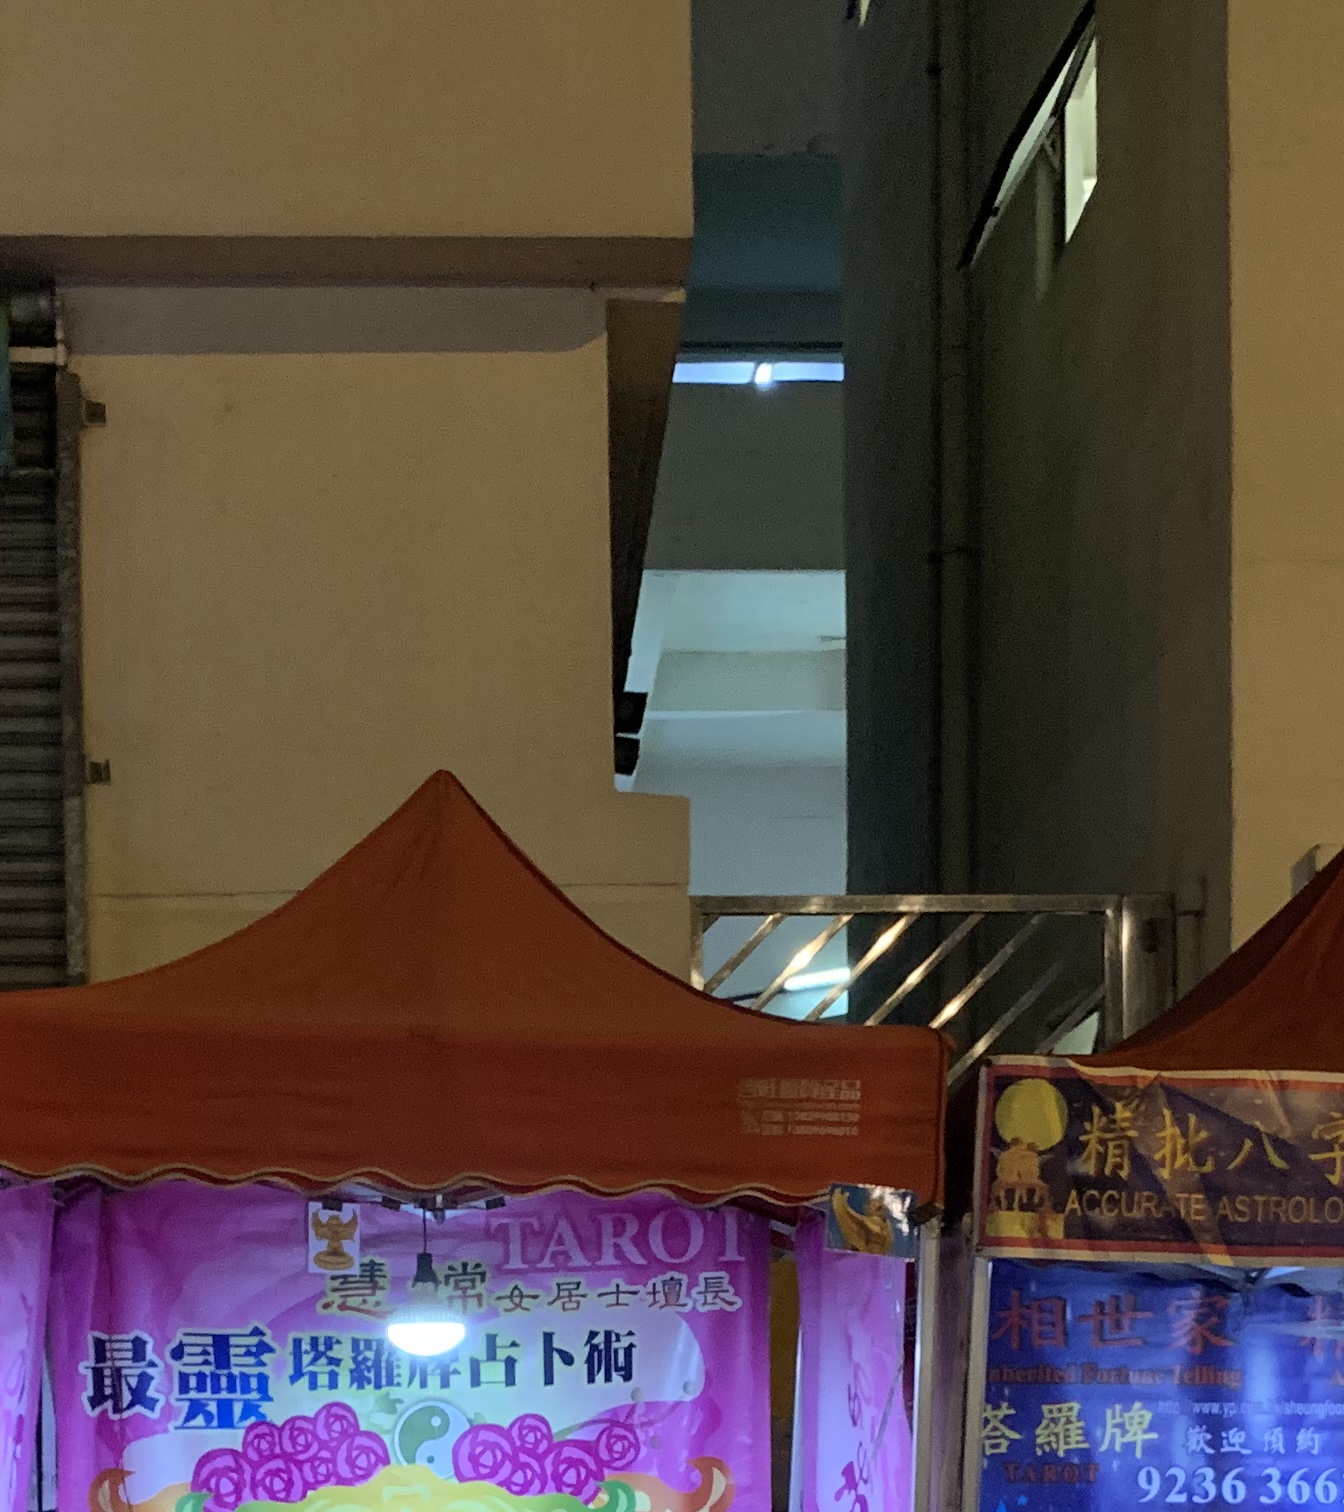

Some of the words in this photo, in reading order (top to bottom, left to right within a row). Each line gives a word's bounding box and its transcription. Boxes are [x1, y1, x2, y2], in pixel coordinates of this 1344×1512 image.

[1064, 1188, 1206, 1222] ACCURATE
[490, 1208, 747, 1271] TAROT
[991, 1288, 1235, 1357] 相世家
[988, 1363, 1075, 1386] nherited
[1002, 1461, 1101, 1484] TAROT
[1137, 1464, 1247, 1504] 9236
